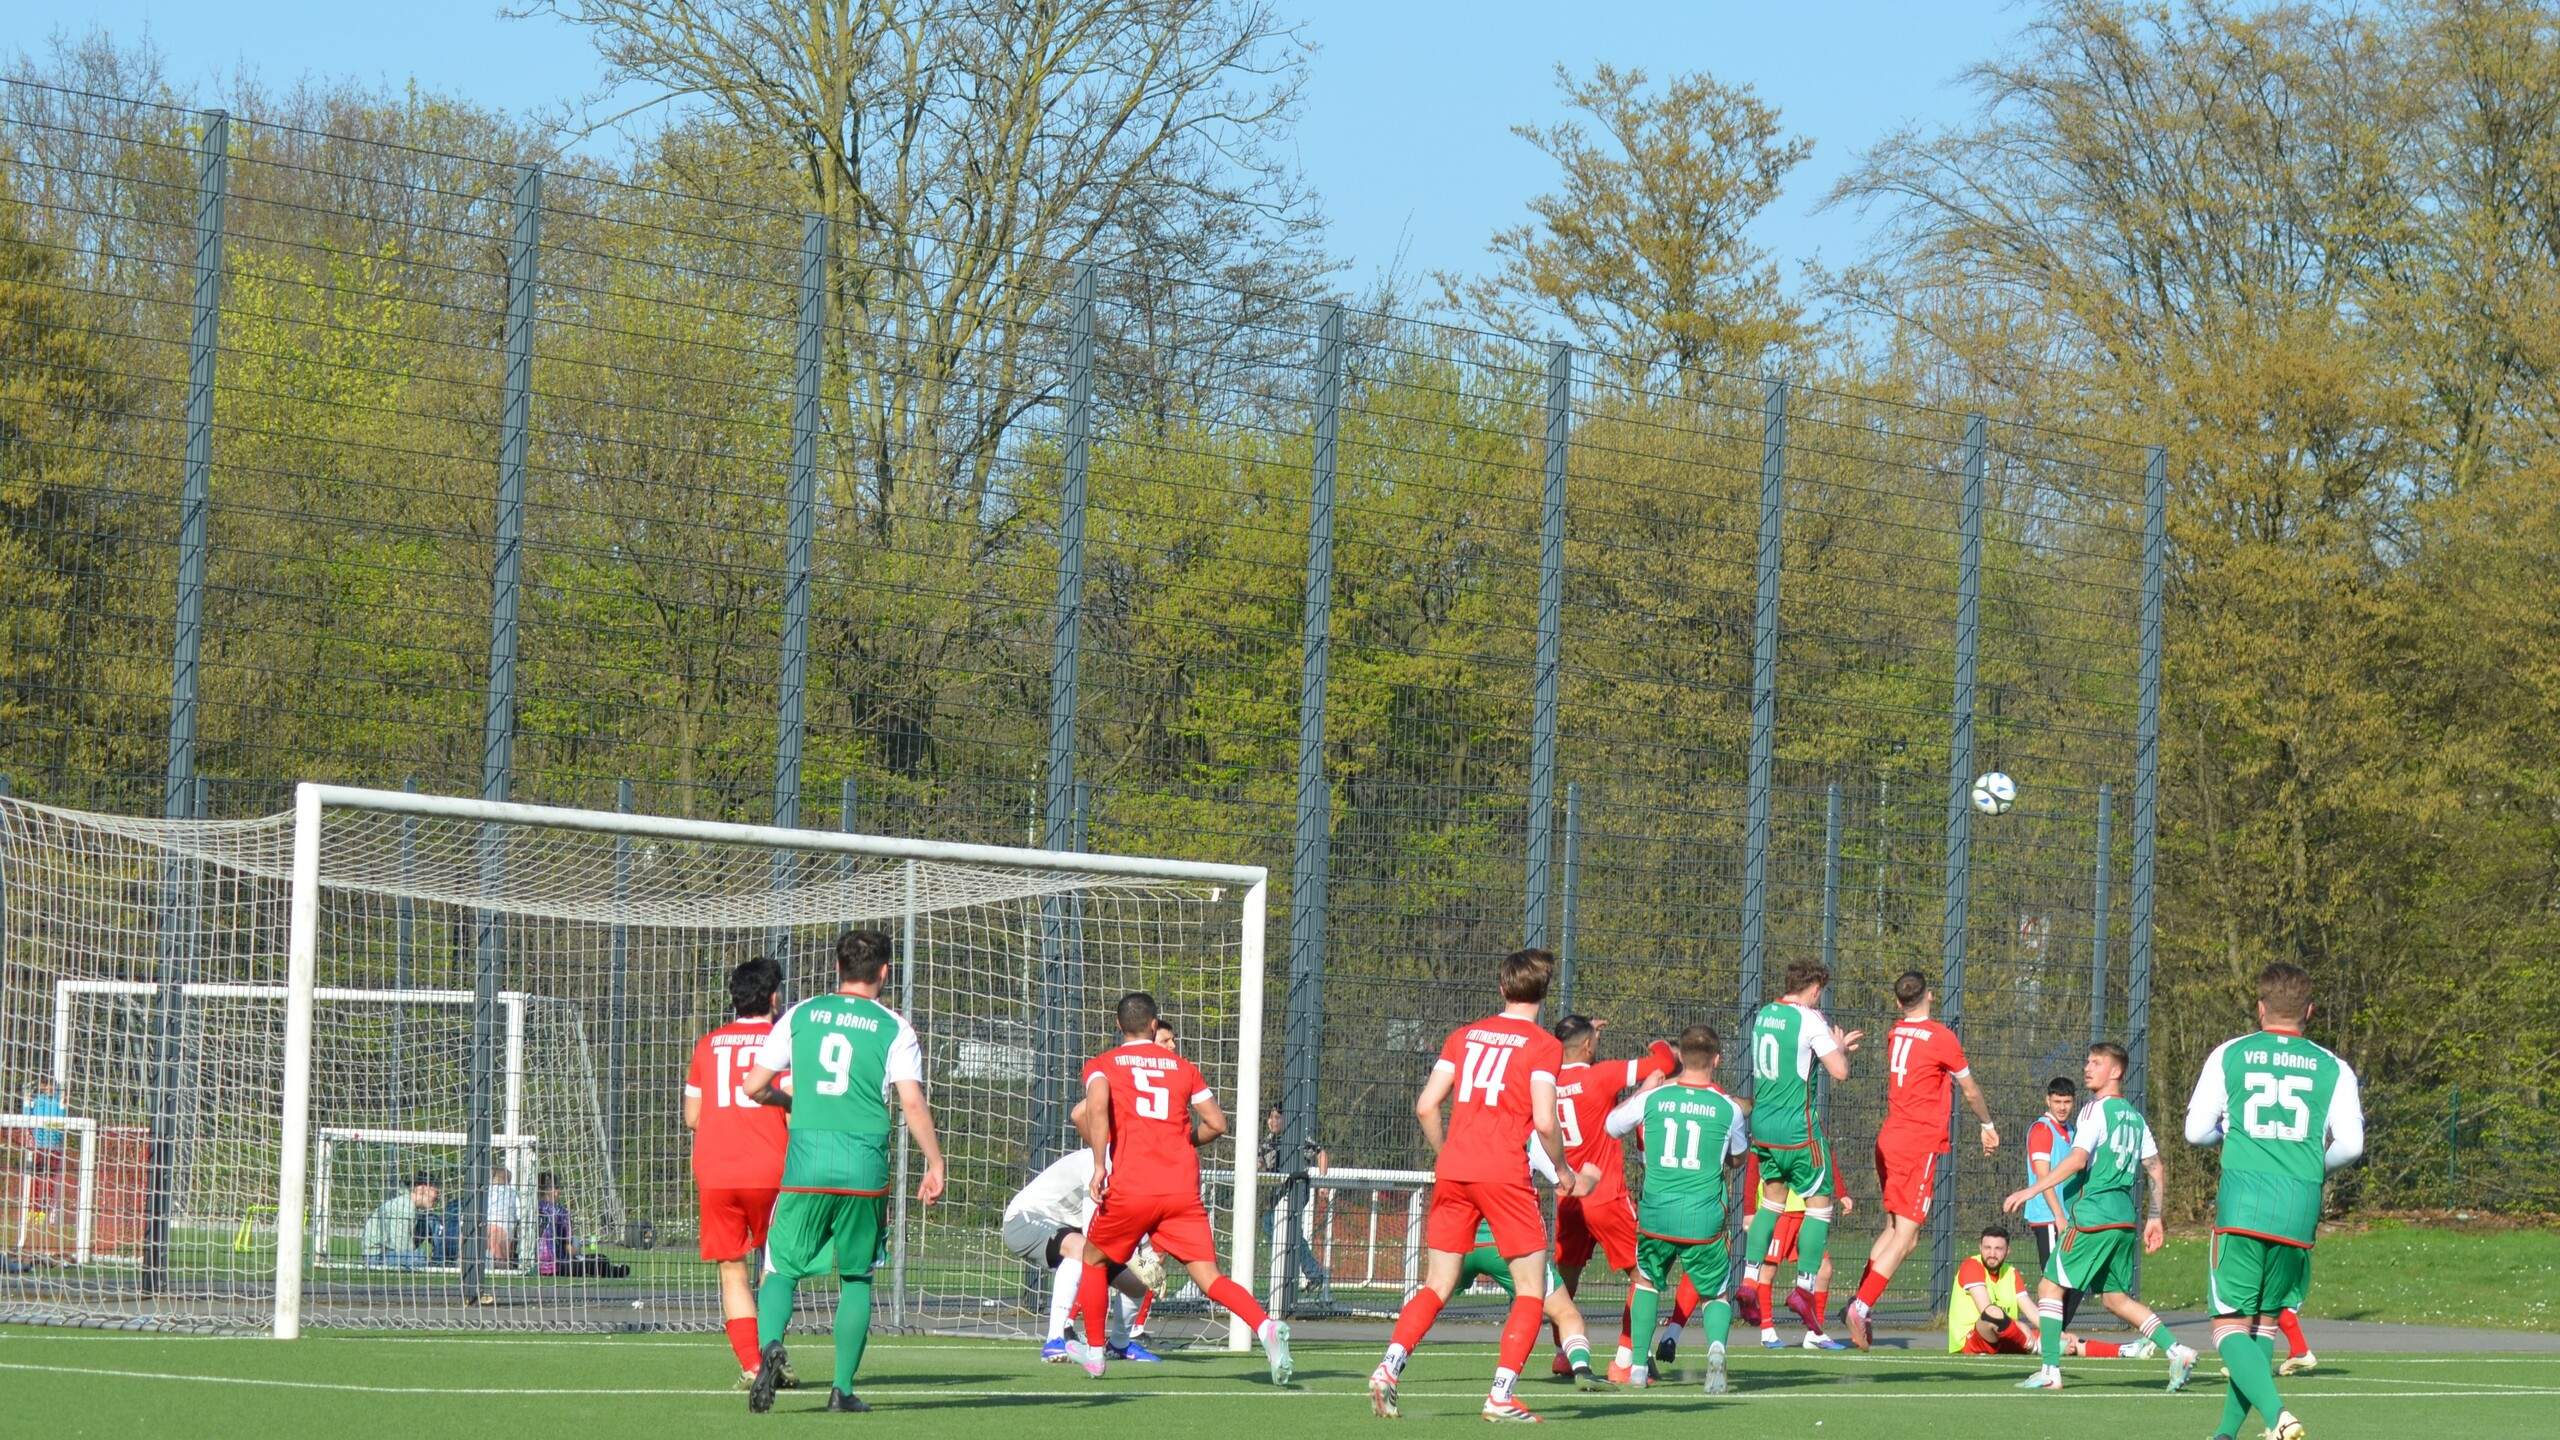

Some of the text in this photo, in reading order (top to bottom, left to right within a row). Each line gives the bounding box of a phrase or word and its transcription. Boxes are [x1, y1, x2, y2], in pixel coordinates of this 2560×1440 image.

[836, 1012, 879, 1032] BÖRNIG
[713, 1046, 763, 1108] 13
[816, 1032, 853, 1096] 9
[1458, 1041, 1513, 1106] 14
[1891, 1035, 1912, 1088] 4
[2273, 1051, 2317, 1071] BÖRNIG
[1131, 1067, 1169, 1120] 5
[1680, 1101, 1716, 1117] BÖRNIG
[2244, 1072, 2313, 1141] 25
[1660, 1117, 1700, 1170] 11
